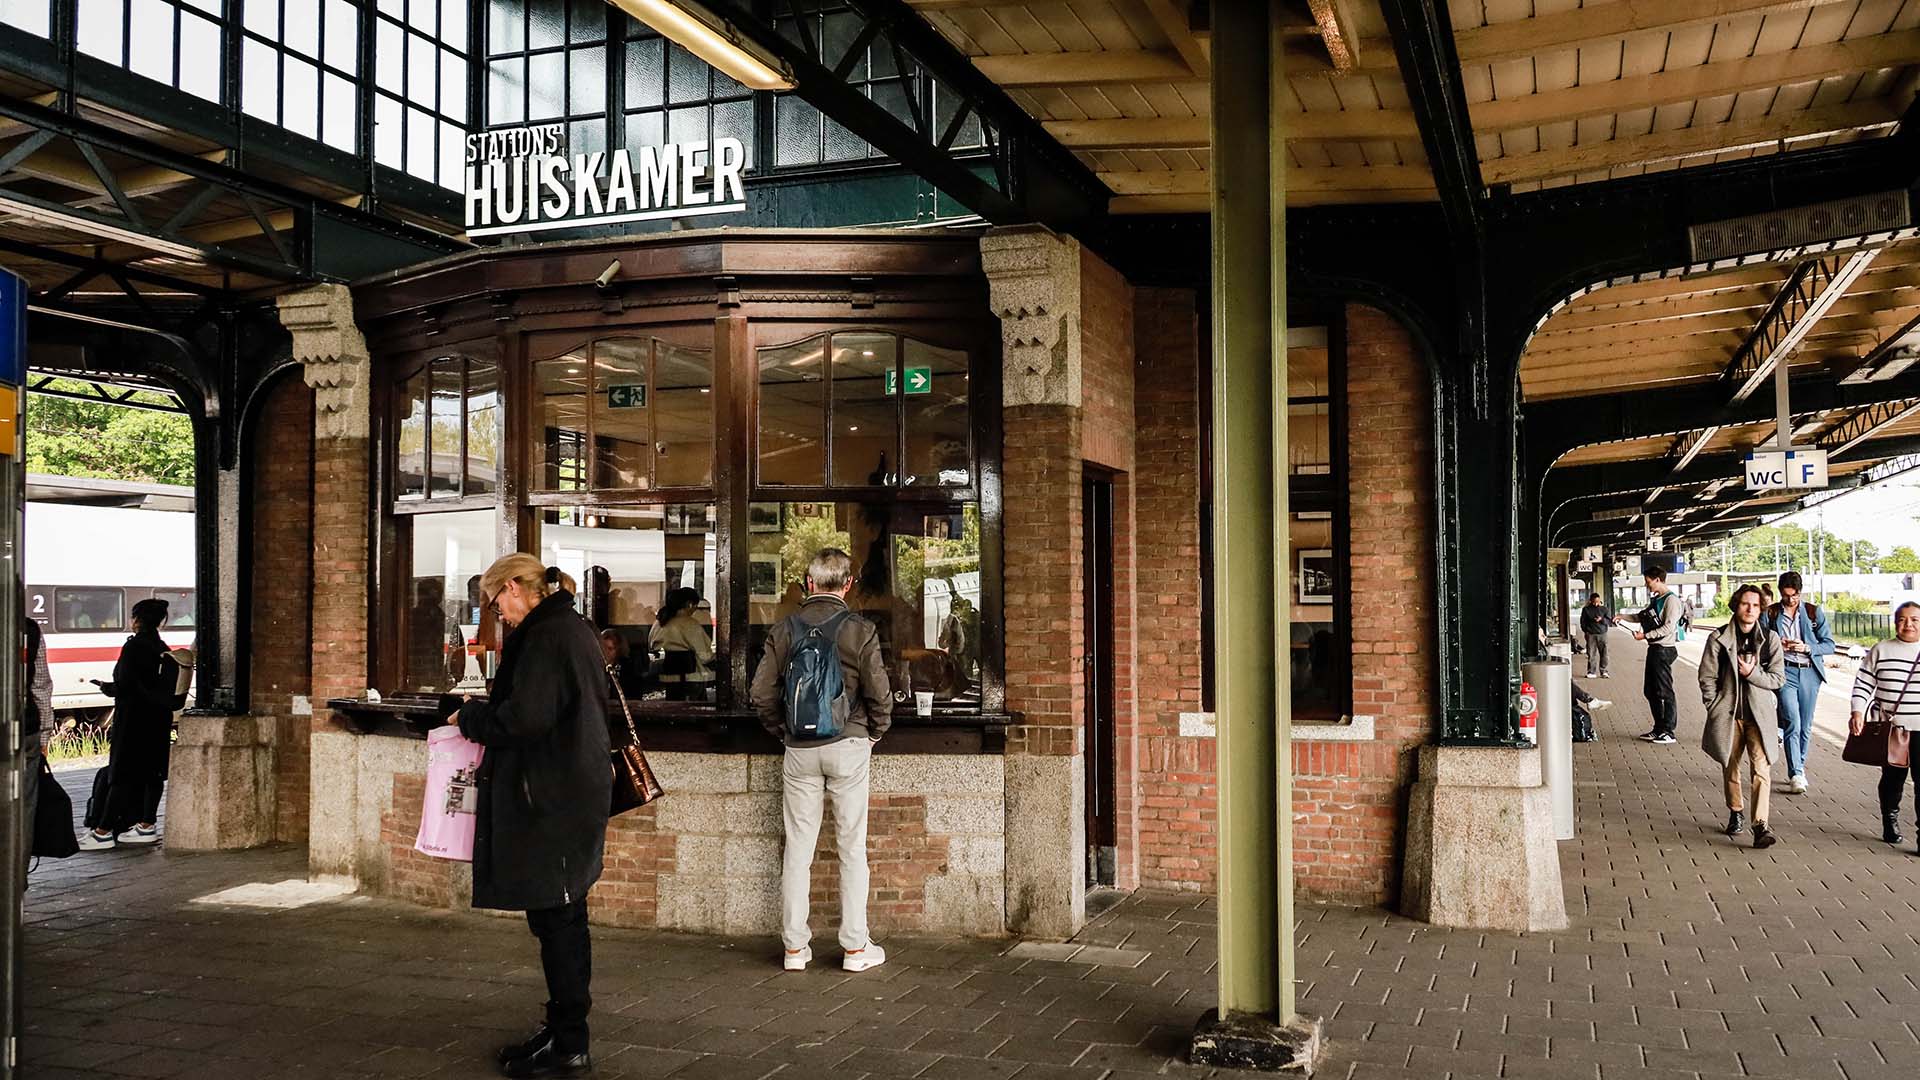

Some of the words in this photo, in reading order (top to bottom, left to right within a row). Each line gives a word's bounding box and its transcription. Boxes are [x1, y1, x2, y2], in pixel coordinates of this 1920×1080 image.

[466, 125, 560, 163] STATIONS
[465, 136, 746, 227] HUISKAMER
[1750, 470, 1783, 486] WC
[1802, 463, 1815, 484] F
[1652, 541, 1658, 550] E
[32, 594, 45, 613] 2
